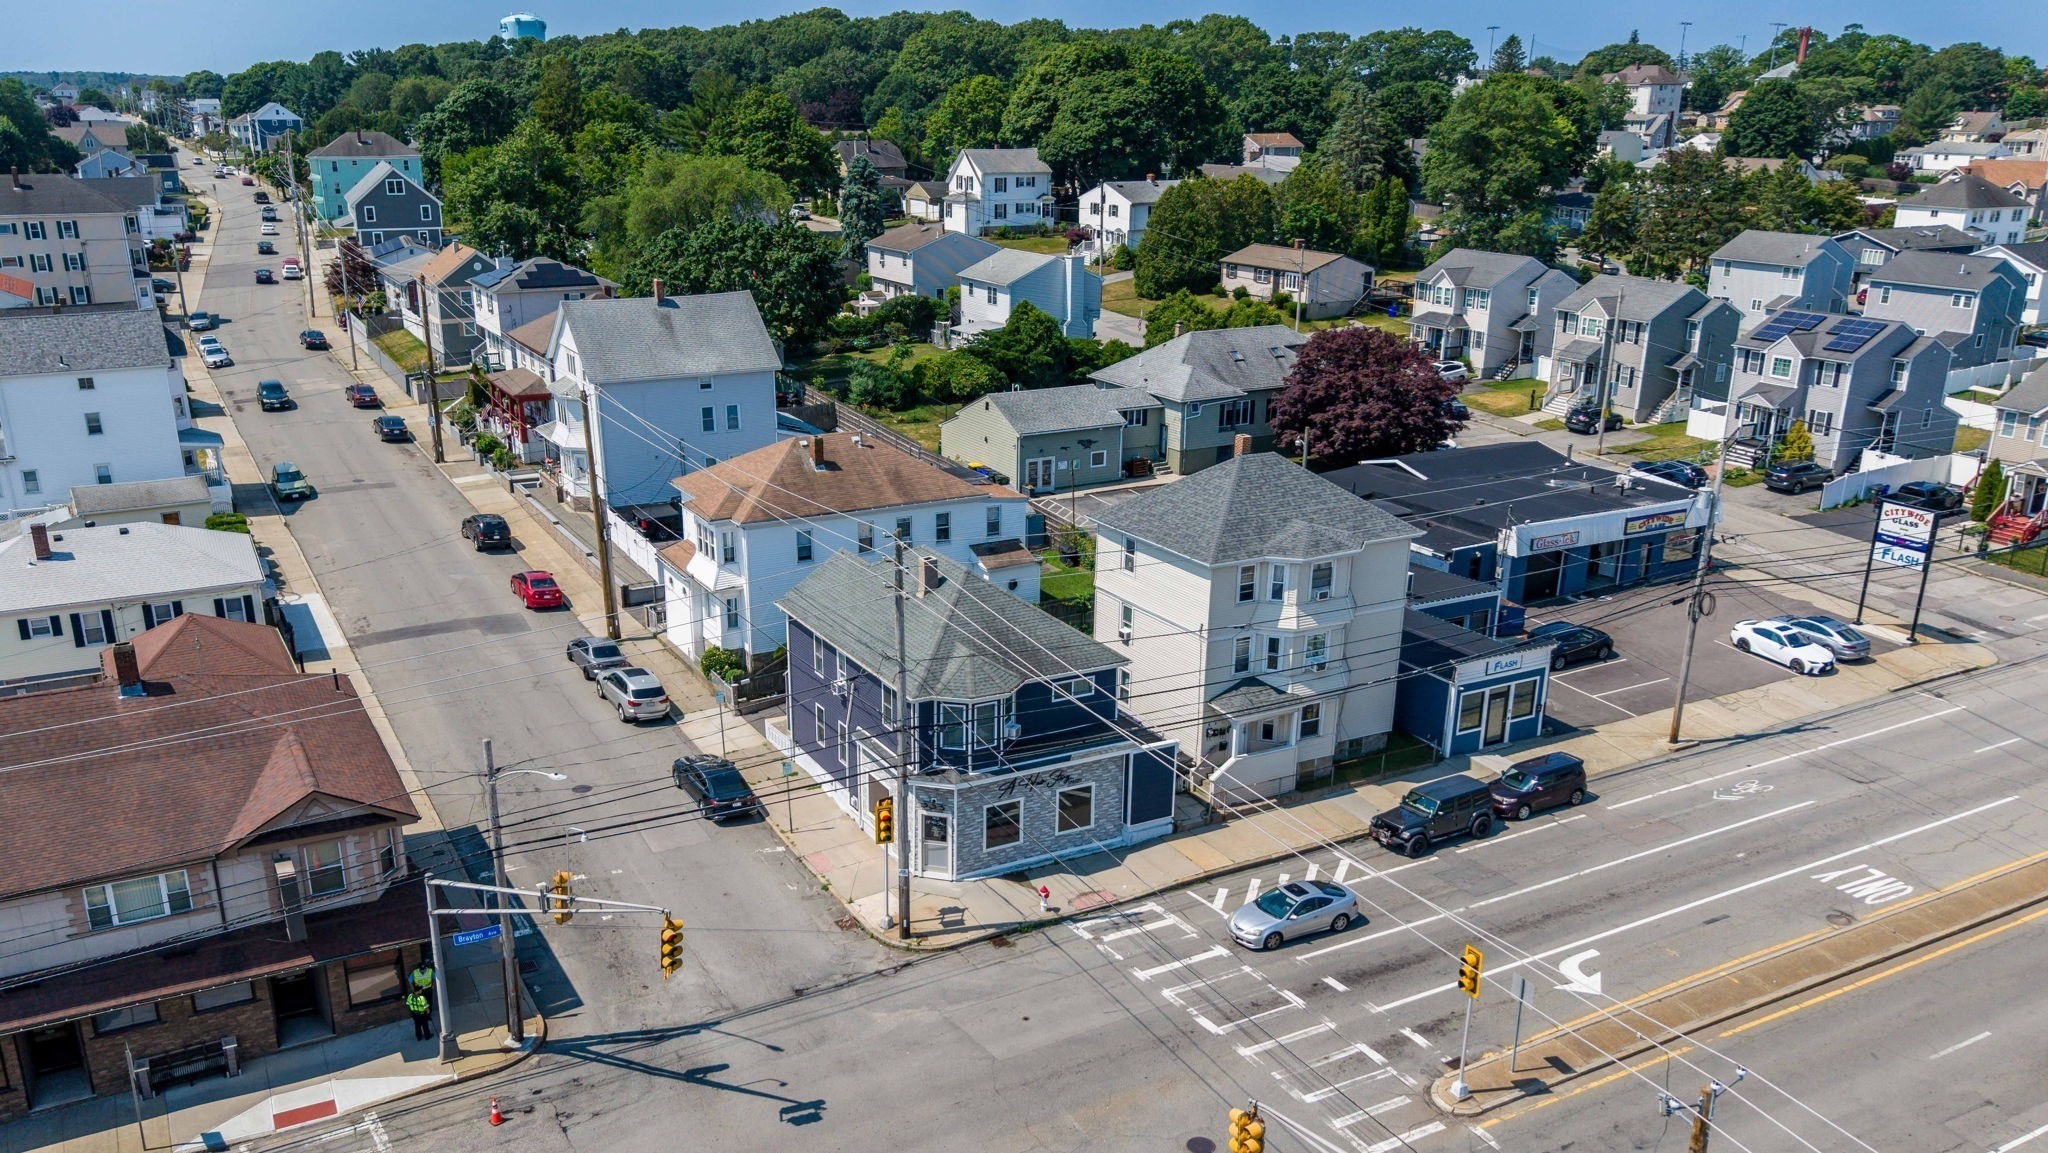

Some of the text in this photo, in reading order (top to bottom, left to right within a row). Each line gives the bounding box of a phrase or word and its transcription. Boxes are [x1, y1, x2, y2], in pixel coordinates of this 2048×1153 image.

[1638, 515, 1674, 529] CITYWIDE
[1884, 508, 1931, 527] CITYWIDE
[1892, 517, 1919, 529] GLASS
[1881, 548, 1919, 566] FLASH
[1494, 659, 1518, 672] FLASH
[1810, 864, 1913, 904] ONLY
[457, 932, 484, 943] Brayton
